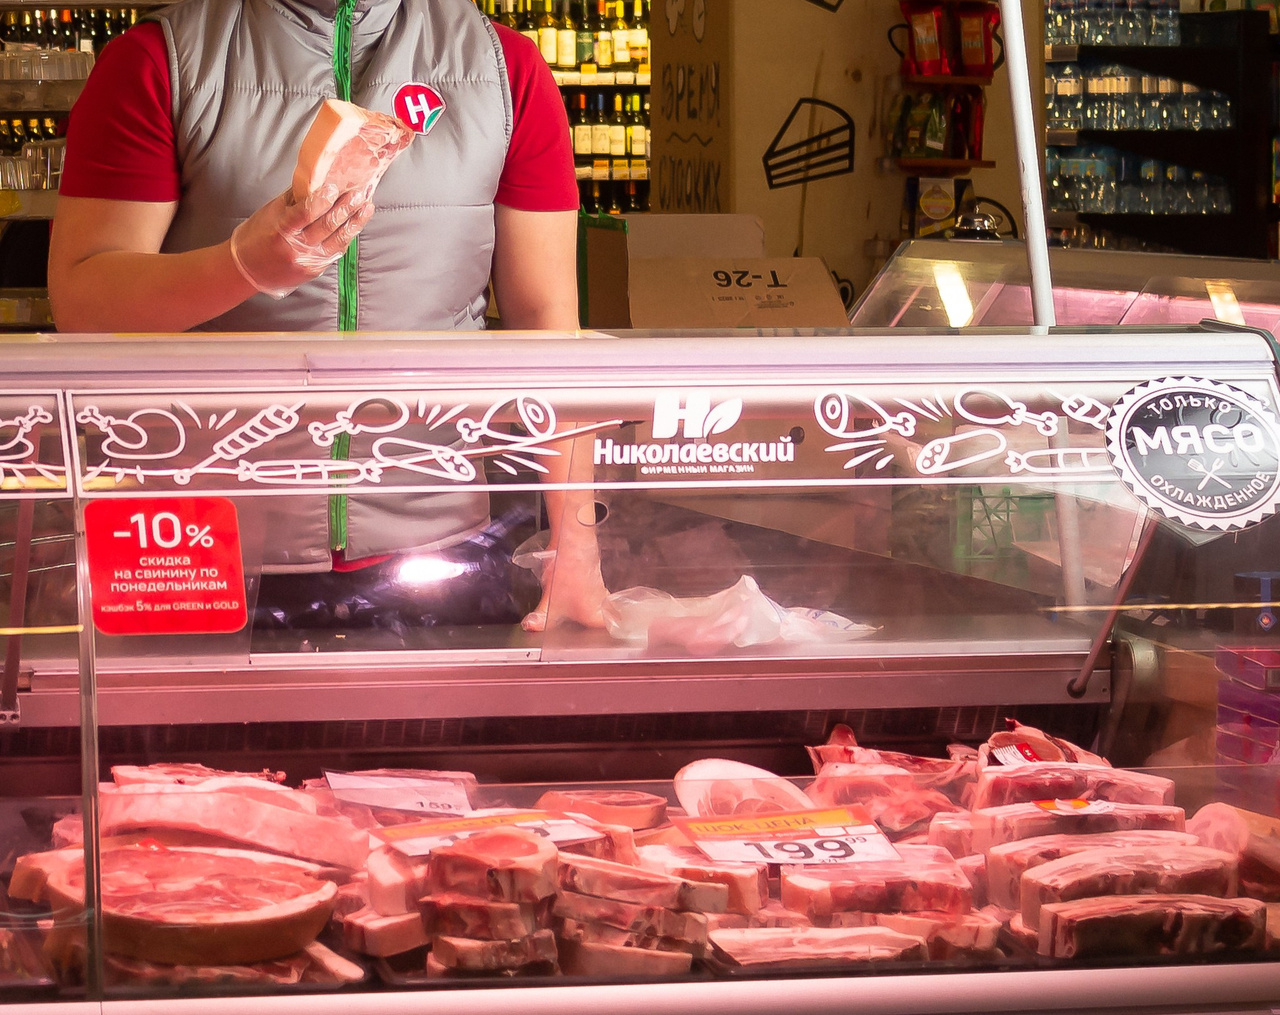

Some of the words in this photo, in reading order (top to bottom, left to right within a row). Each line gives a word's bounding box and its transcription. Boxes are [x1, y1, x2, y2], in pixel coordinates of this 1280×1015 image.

[712, 270, 788, 288] T-26
[1147, 395, 1231, 415] ТОЛЬКО
[1132, 423, 1265, 456] МЯСО
[593, 436, 795, 465] Николаевский
[710, 464, 754, 473] МАГАЗИН
[1150, 470, 1271, 510] ОХЛАЖДЕННОЕ
[113, 512, 214, 549] -10%
[139, 556, 191, 567] скидка
[114, 570, 131, 580] на
[135, 568, 197, 581] свинину
[200, 568, 218, 578] по
[110, 580, 228, 593] понедельникам
[101, 604, 134, 613] кэшбэк
[136, 600, 152, 612] 5%
[154, 603, 171, 612] для
[172, 602, 205, 611] GREEN
[213, 601, 239, 611] GOLD
[696, 822, 745, 833] ШОК
[754, 815, 816, 831] ЦЕНА
[744, 839, 855, 860] 199
